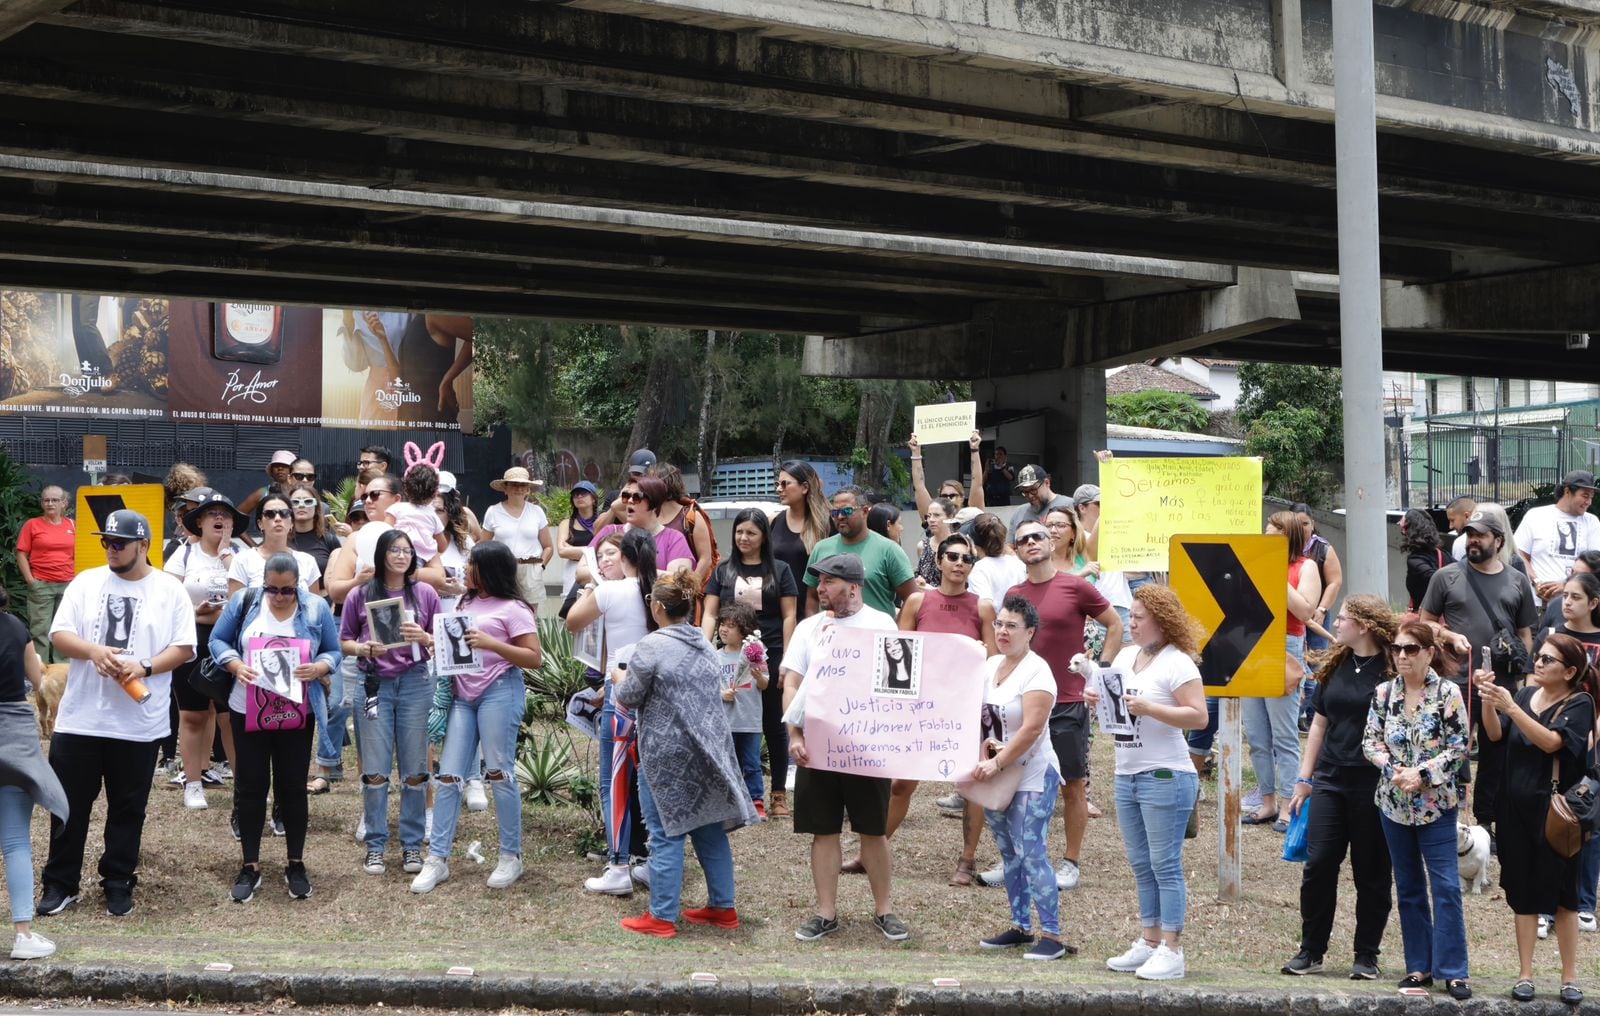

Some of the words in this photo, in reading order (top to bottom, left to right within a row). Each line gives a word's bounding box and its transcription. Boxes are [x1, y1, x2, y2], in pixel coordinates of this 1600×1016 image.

[221, 368, 244, 401] Por
[240, 370, 279, 404] Amor
[172, 410, 179, 418] EL
[199, 411, 206, 419] DE
[207, 412, 222, 420] LICOR
[232, 413, 251, 422] NOCIVO
[266, 415, 273, 423] LA
[935, 420, 968, 428] FEMINICIDA
[944, 414, 972, 422] CULPABLE
[839, 697, 903, 715] Justicia
[908, 699, 935, 714] para
[919, 718, 962, 733] Fabiola
[827, 738, 901, 754] Lucharemos
